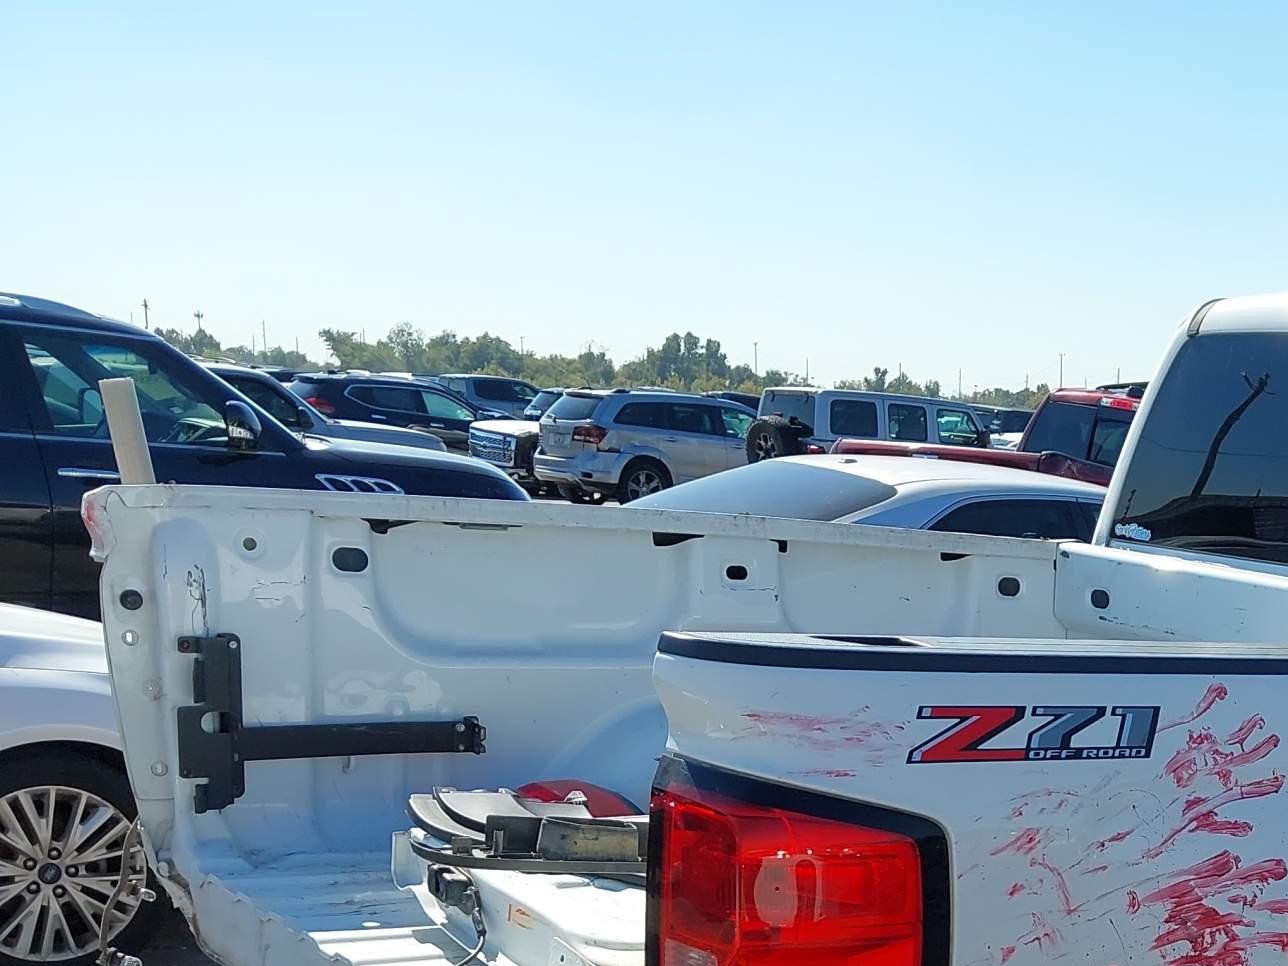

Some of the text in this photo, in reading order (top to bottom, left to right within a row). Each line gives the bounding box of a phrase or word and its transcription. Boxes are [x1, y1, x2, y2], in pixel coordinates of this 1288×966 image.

[906, 705, 1160, 763] Z71
[1028, 748, 1146, 759] OFF ROAD
